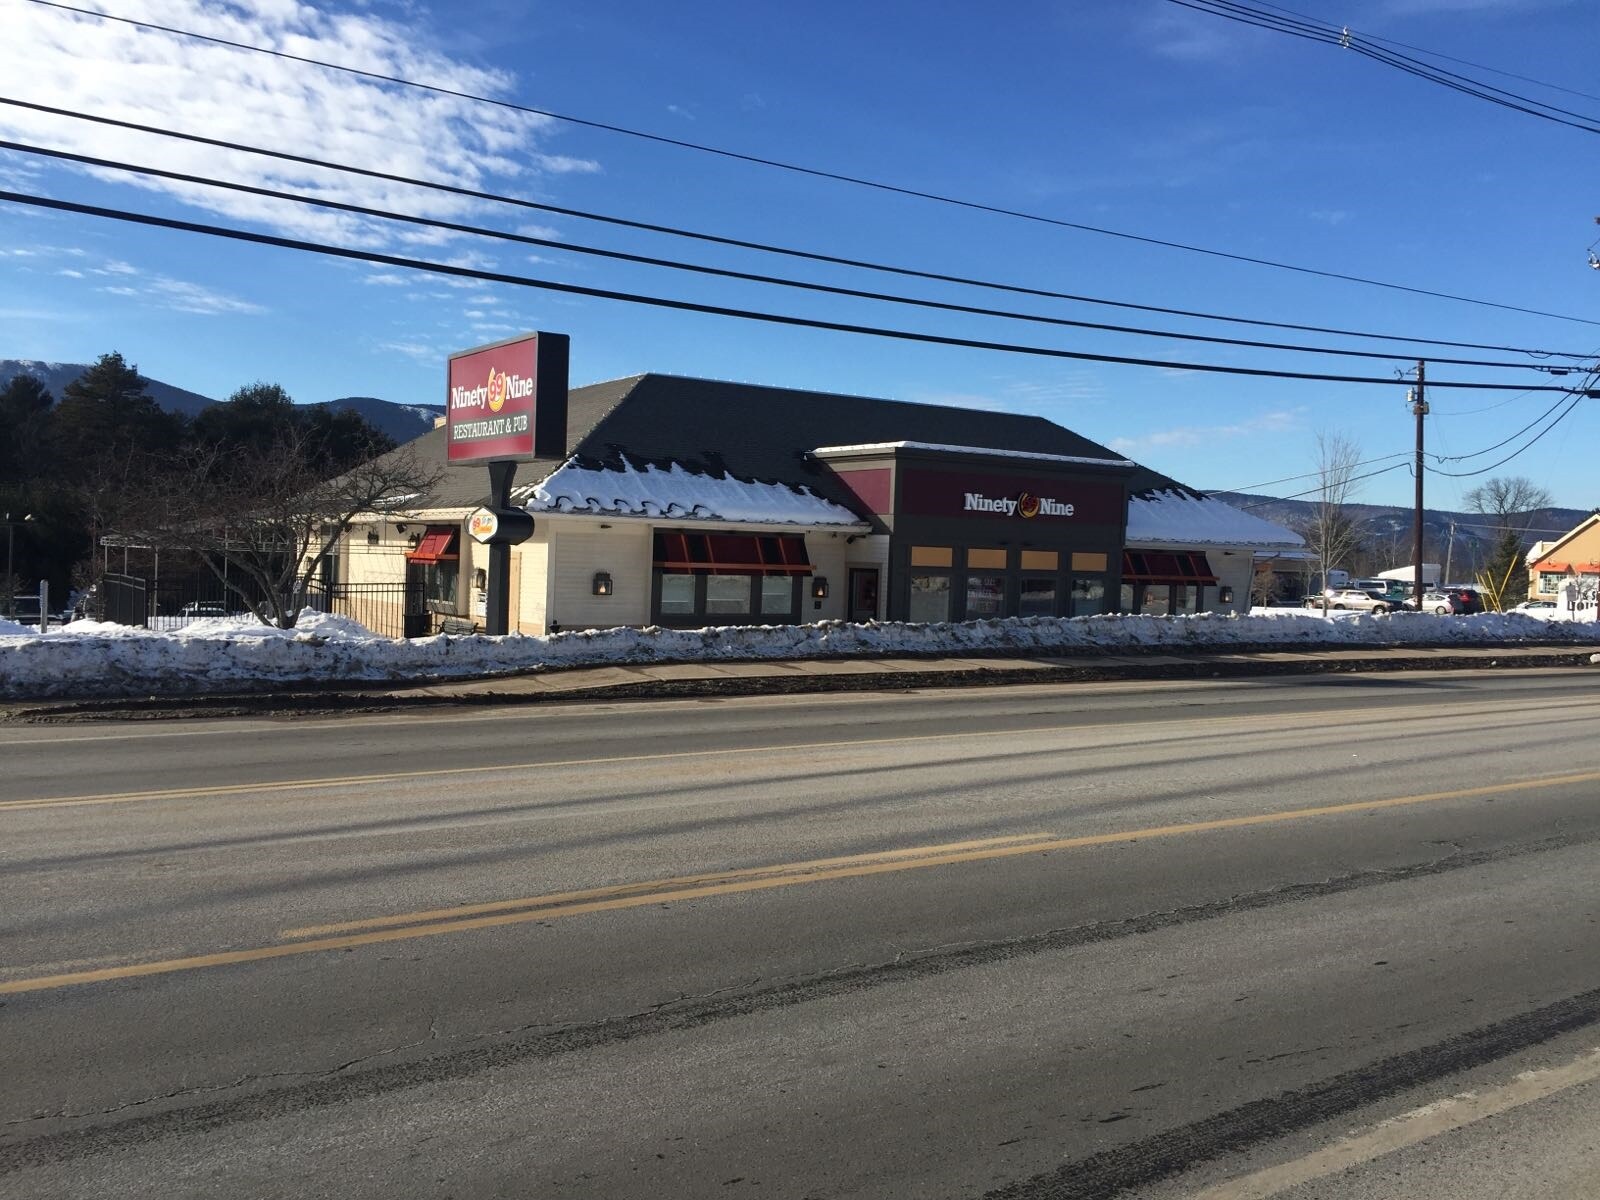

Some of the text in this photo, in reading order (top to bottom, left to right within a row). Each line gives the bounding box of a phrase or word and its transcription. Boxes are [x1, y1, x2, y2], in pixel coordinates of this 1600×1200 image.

[451, 384, 488, 410] Ninety
[506, 375, 533, 400] Nine
[453, 415, 528, 440] RESTAURANT & PUB
[964, 493, 1017, 516] Ninety
[1040, 498, 1074, 516] Nine
